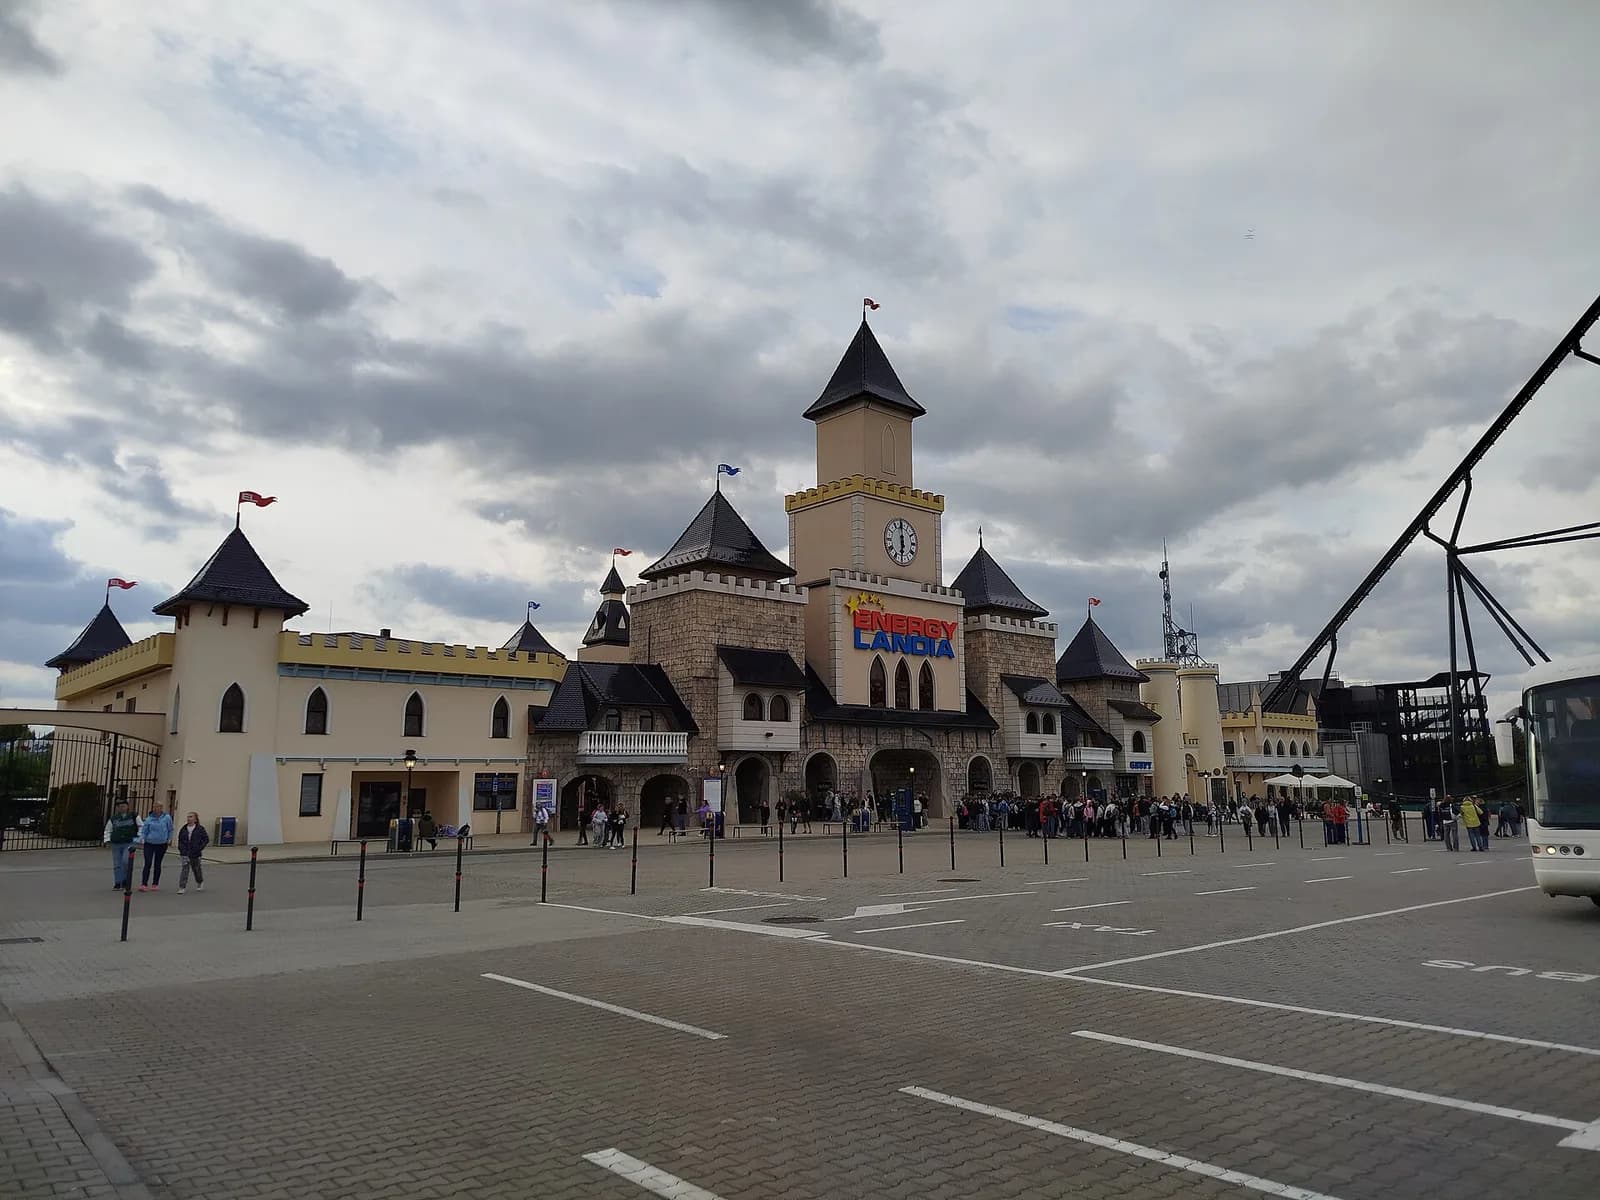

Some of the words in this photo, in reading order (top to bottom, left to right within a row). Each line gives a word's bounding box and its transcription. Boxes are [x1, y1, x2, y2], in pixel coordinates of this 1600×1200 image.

[853, 609, 958, 640] ENERGY
[854, 627, 955, 659] LANDIA
[1421, 959, 1600, 982] BUS
